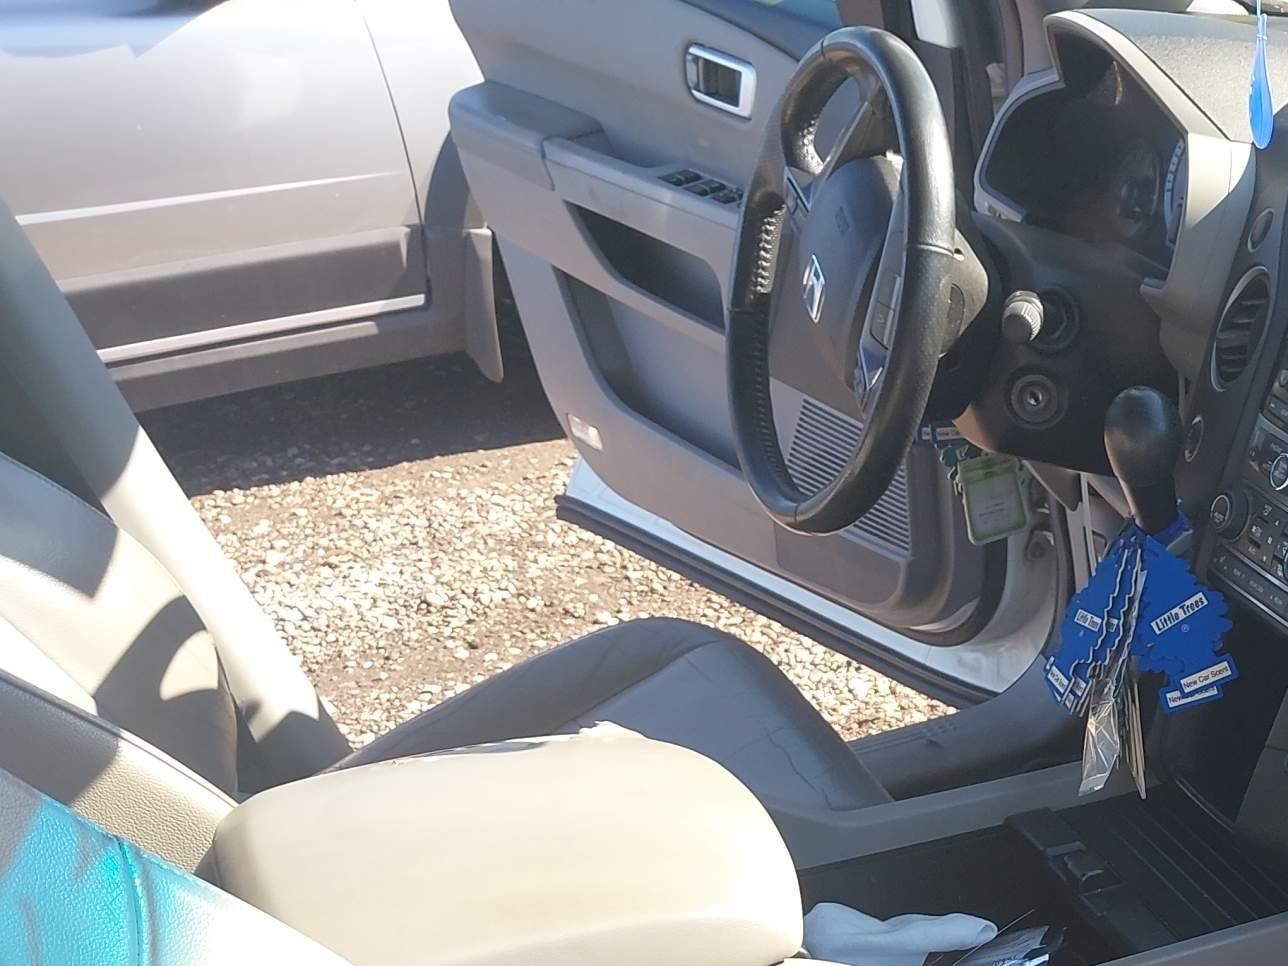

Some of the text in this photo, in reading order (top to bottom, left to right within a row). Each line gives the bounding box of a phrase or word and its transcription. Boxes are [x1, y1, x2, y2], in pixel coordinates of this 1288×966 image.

[1154, 597, 1205, 632] Little Trees
[1183, 679, 1198, 689] New
[1198, 673, 1210, 683] Car
